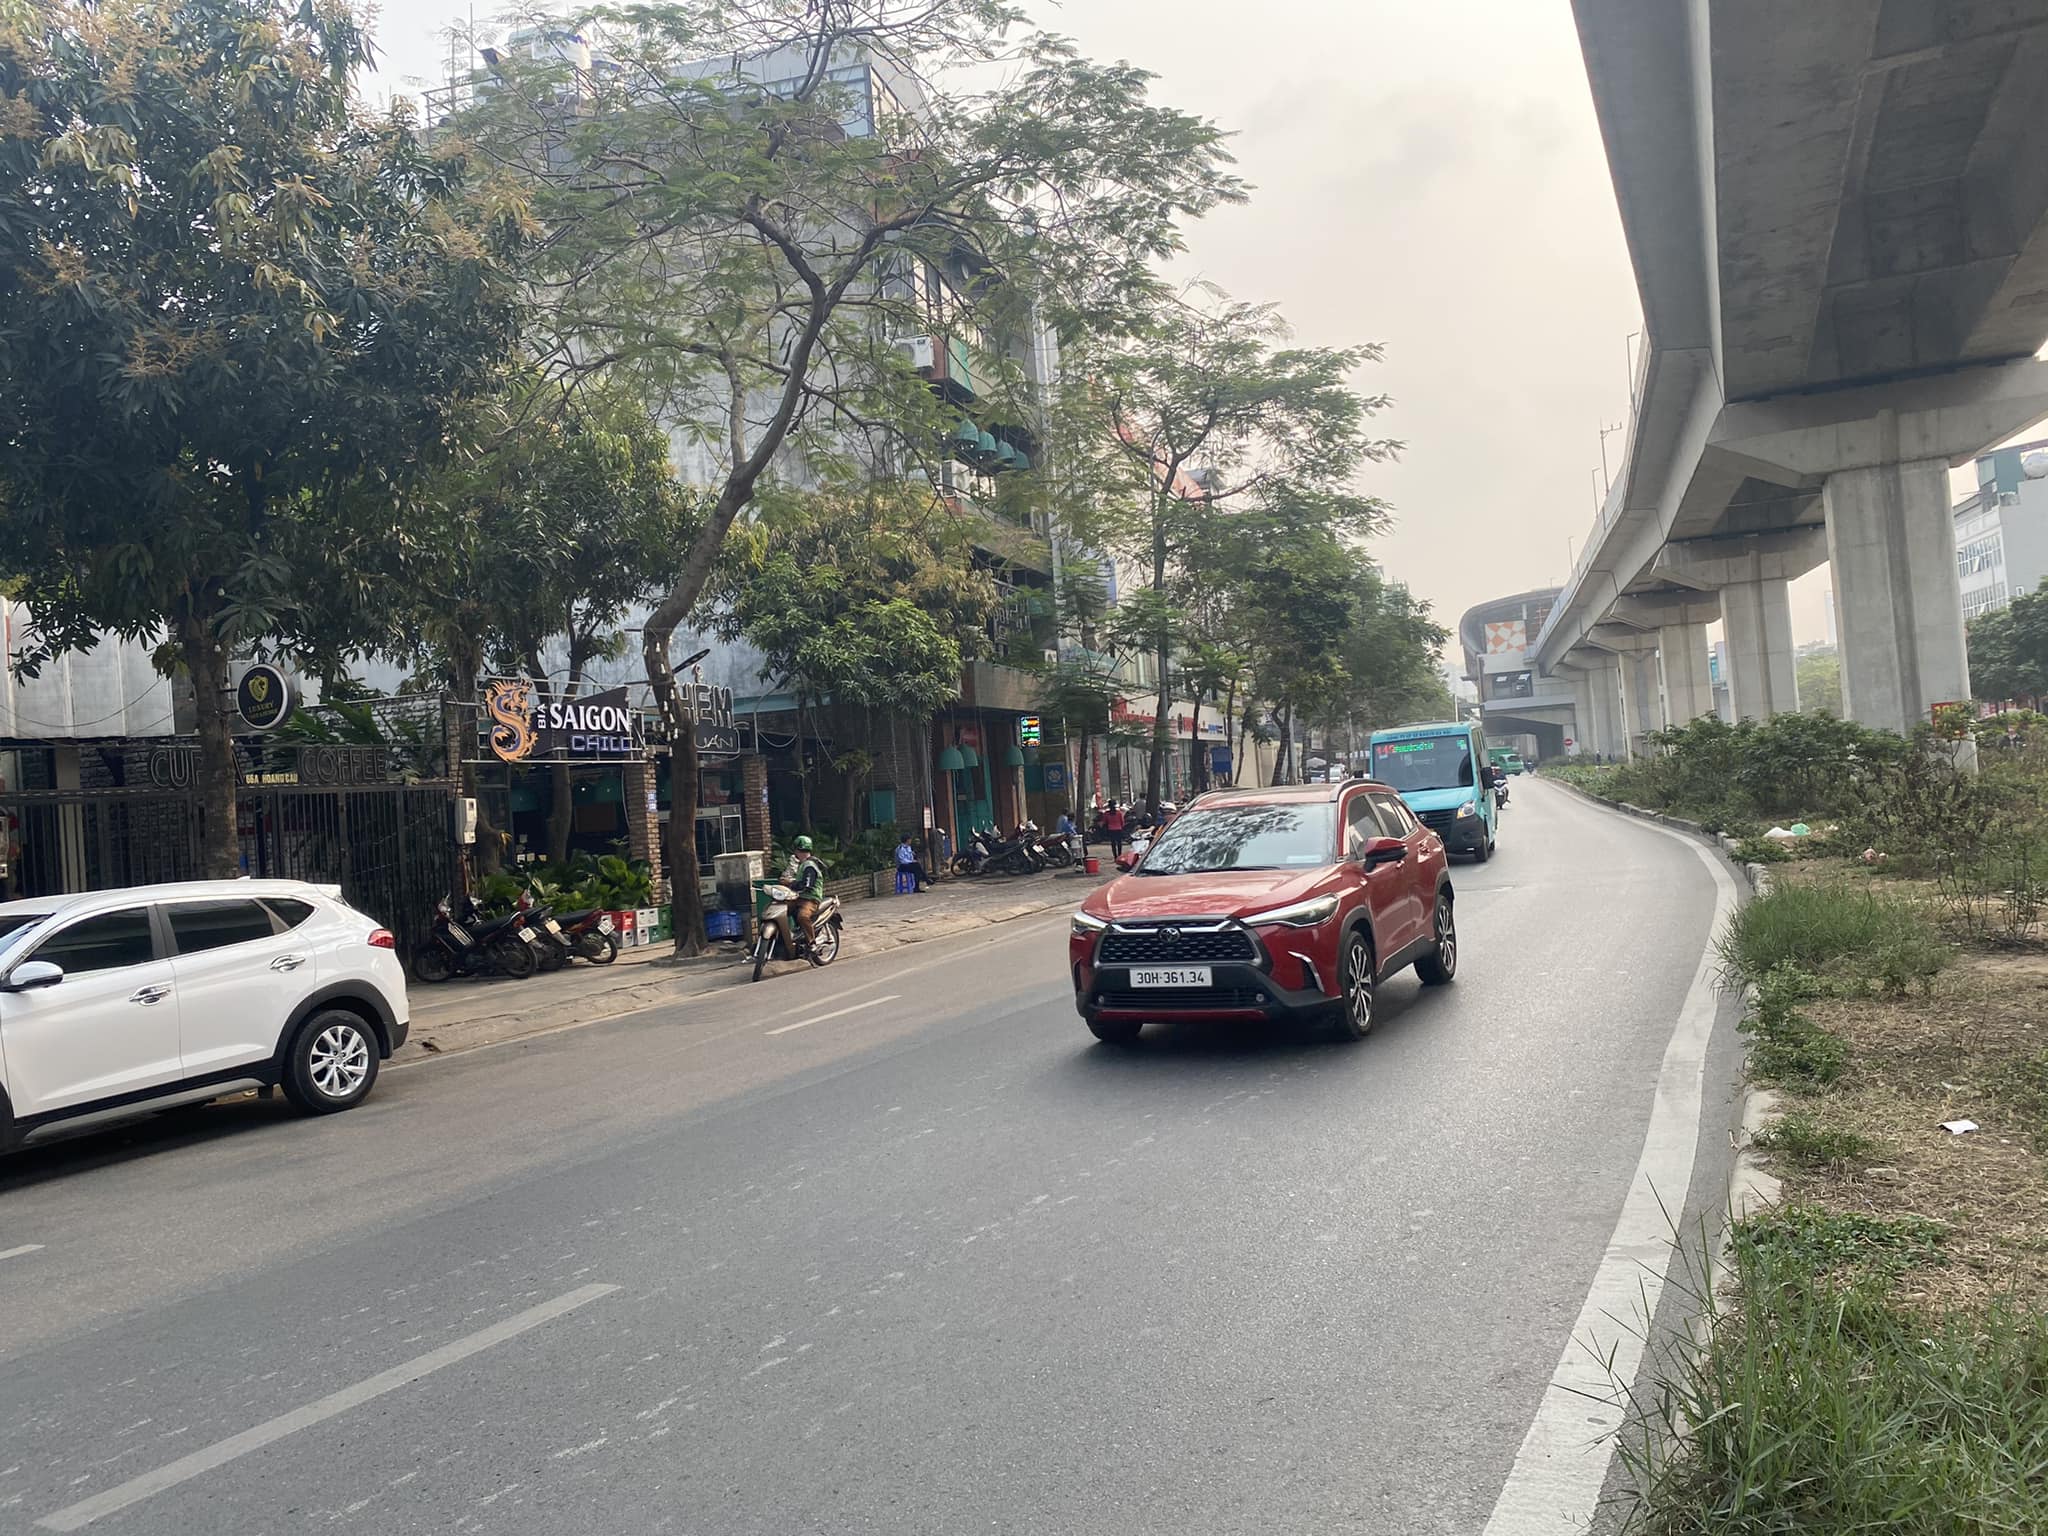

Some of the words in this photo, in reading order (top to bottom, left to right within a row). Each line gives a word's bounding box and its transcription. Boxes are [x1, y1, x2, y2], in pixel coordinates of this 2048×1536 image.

[537, 703, 547, 729] BIA
[549, 703, 630, 732] SAIGON
[695, 734, 733, 748] UÁN
[301, 746, 385, 783] COFFEE
[1137, 971, 1205, 984] 30H-361.34
